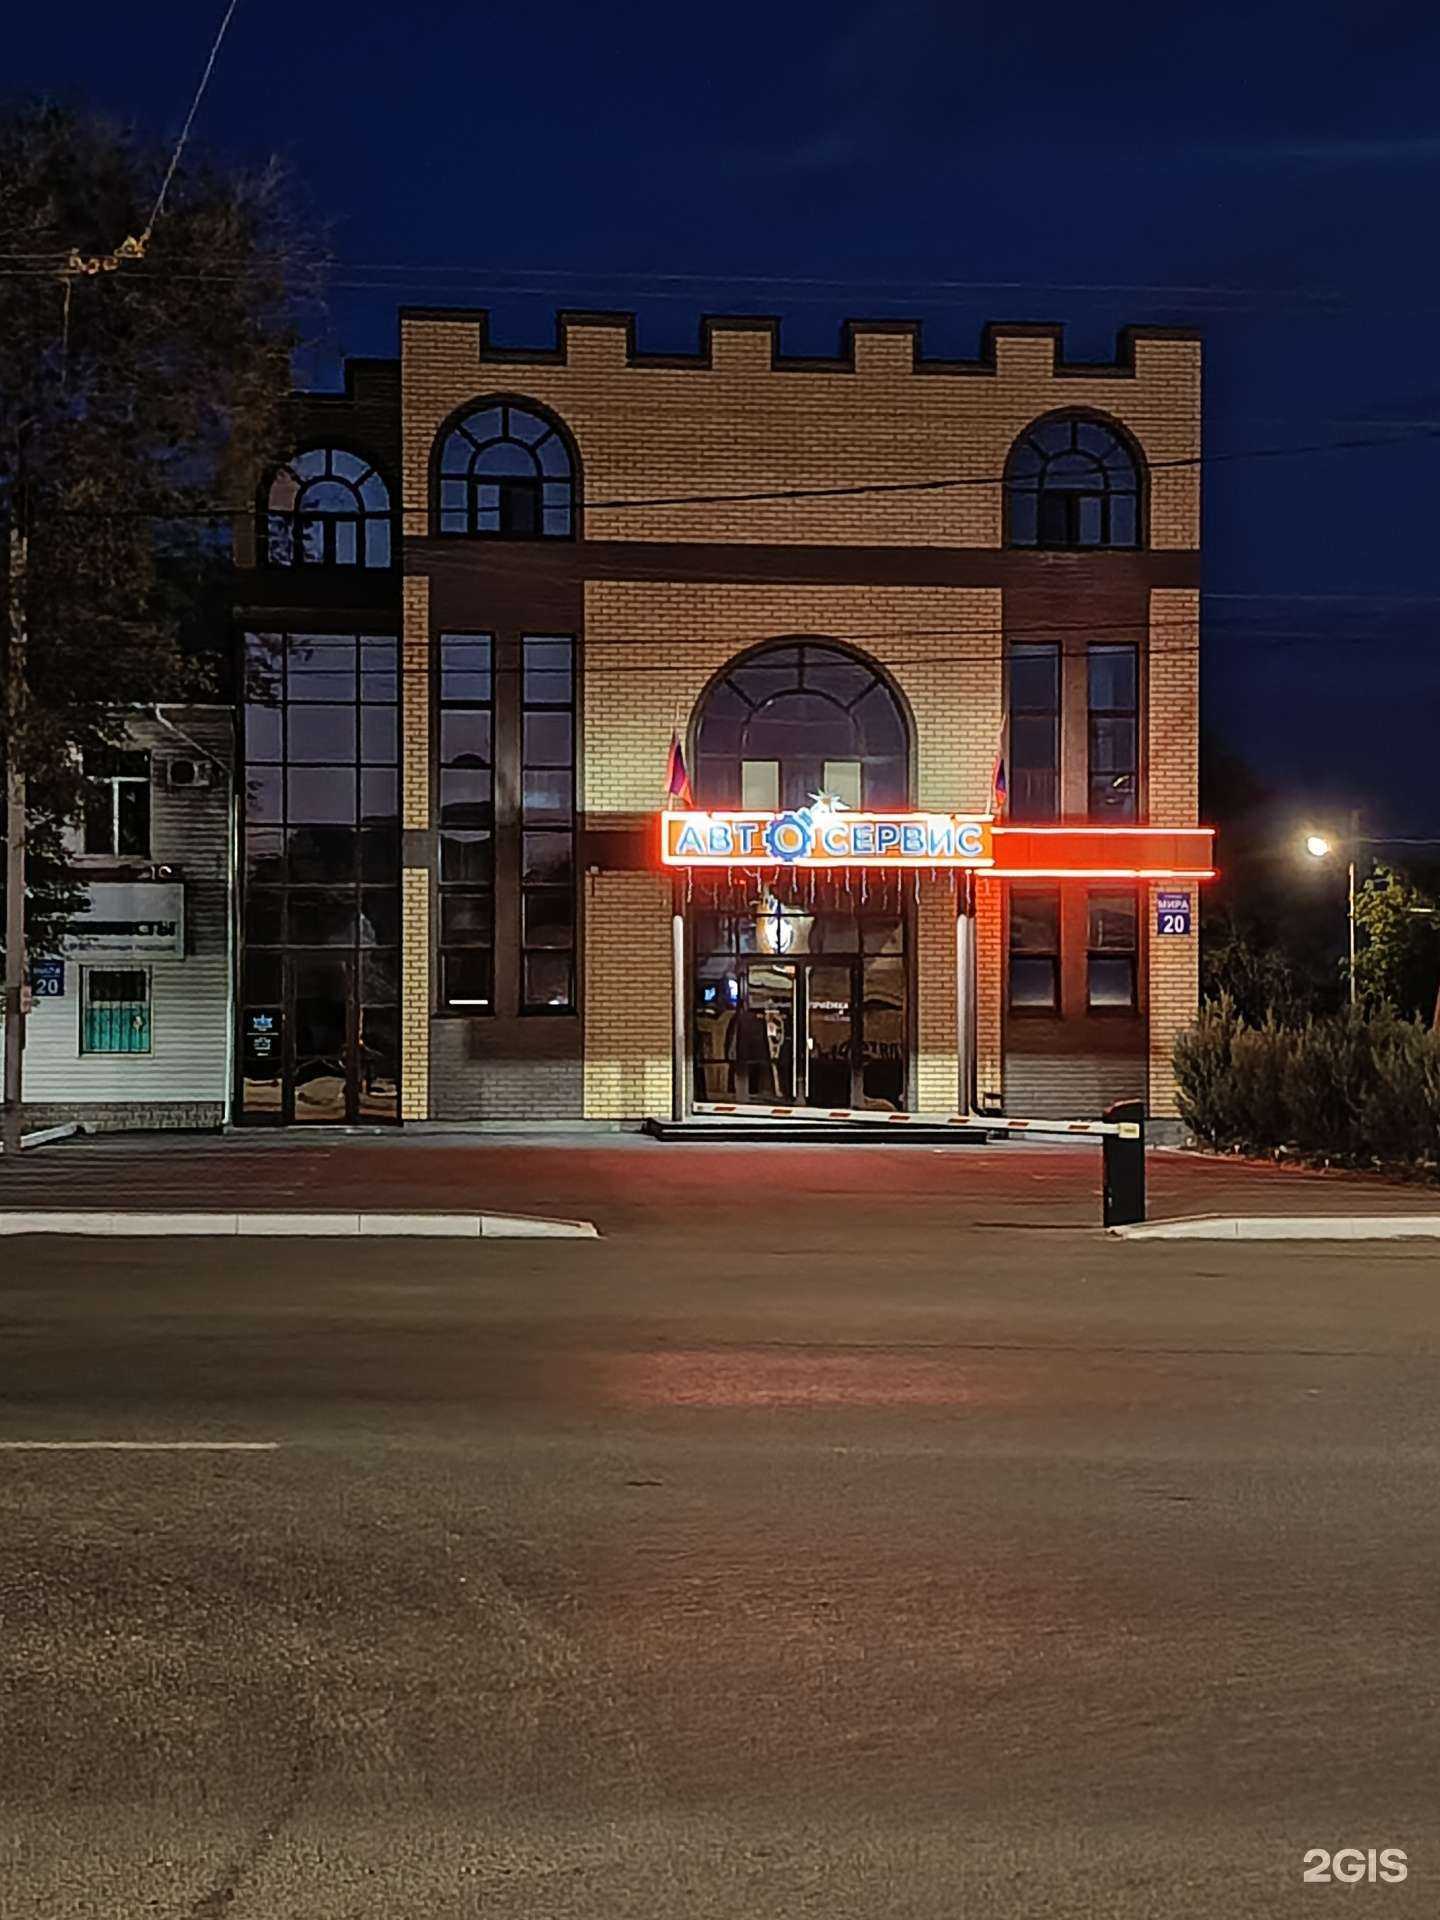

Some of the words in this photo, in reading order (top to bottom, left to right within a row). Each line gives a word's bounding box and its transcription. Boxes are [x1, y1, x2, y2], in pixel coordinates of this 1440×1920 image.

[1158, 899, 1189, 909] МИРА
[1163, 914, 1185, 933] 20
[36, 978, 59, 995] 20
